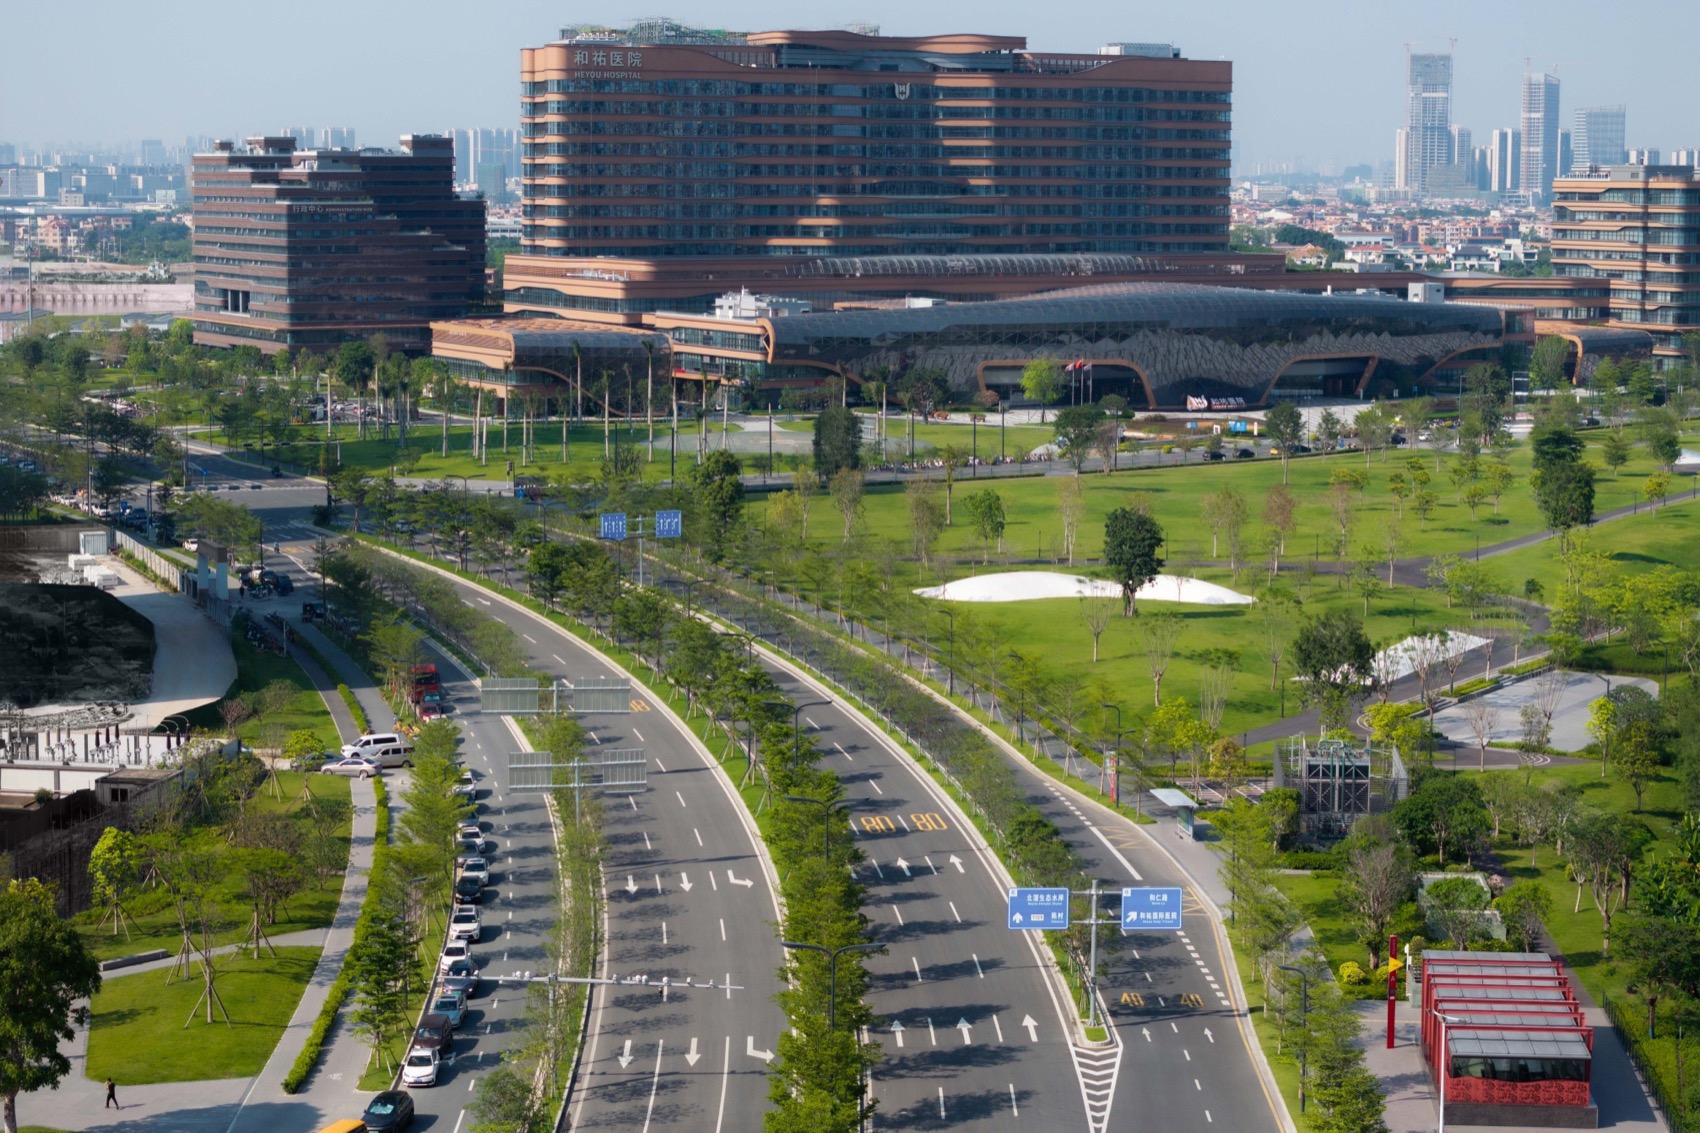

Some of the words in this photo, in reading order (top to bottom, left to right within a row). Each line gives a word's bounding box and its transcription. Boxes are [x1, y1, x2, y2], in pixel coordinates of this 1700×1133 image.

[574, 50, 642, 67] 和祐医院
[574, 71, 602, 79] HEYOU
[603, 71, 641, 79] HOSPITAL
[292, 205, 324, 213] 行政中心
[860, 815, 897, 833] 80
[909, 812, 948, 831] 80
